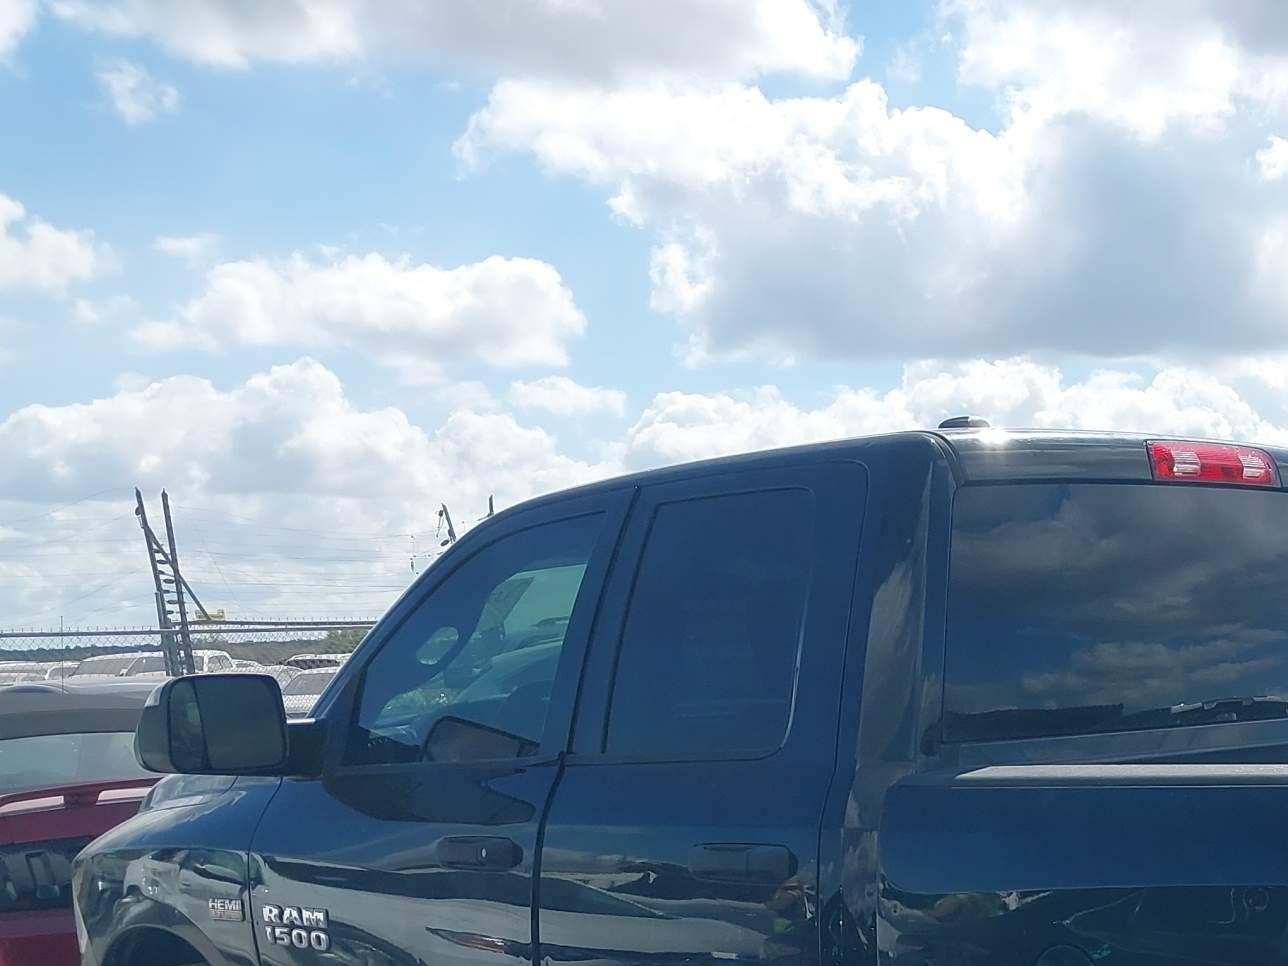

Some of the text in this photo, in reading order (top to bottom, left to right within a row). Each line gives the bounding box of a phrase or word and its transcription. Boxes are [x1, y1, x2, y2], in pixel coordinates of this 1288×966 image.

[208, 898, 242, 911] HEMI
[263, 904, 328, 928] RAM
[265, 926, 330, 951] 1500
